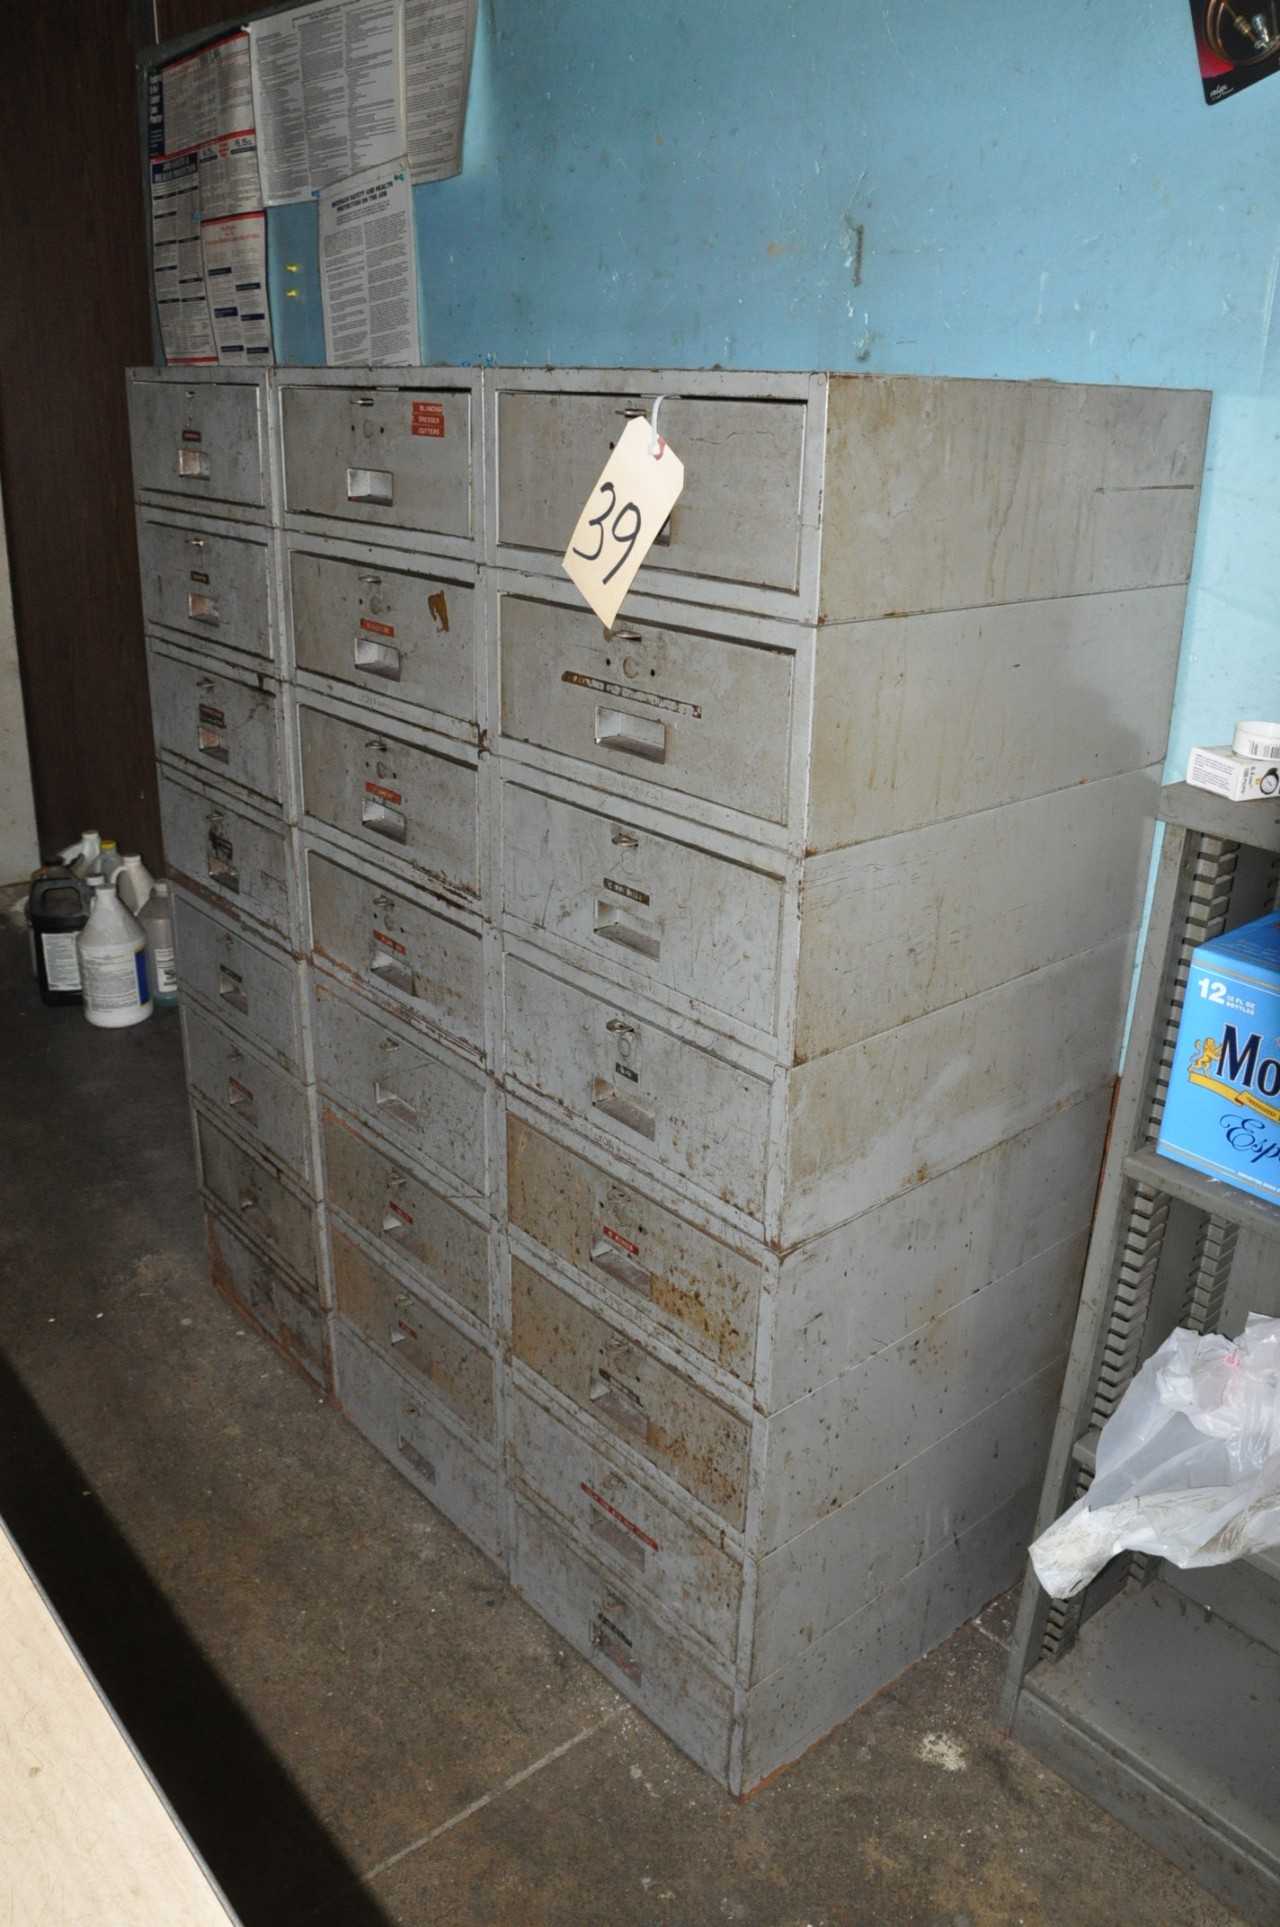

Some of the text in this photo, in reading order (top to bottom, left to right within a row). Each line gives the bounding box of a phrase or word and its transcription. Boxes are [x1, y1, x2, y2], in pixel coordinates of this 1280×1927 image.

[572, 481, 642, 585] 39
[1198, 978, 1227, 1006] 12
[1215, 1022, 1280, 1098] Mo
